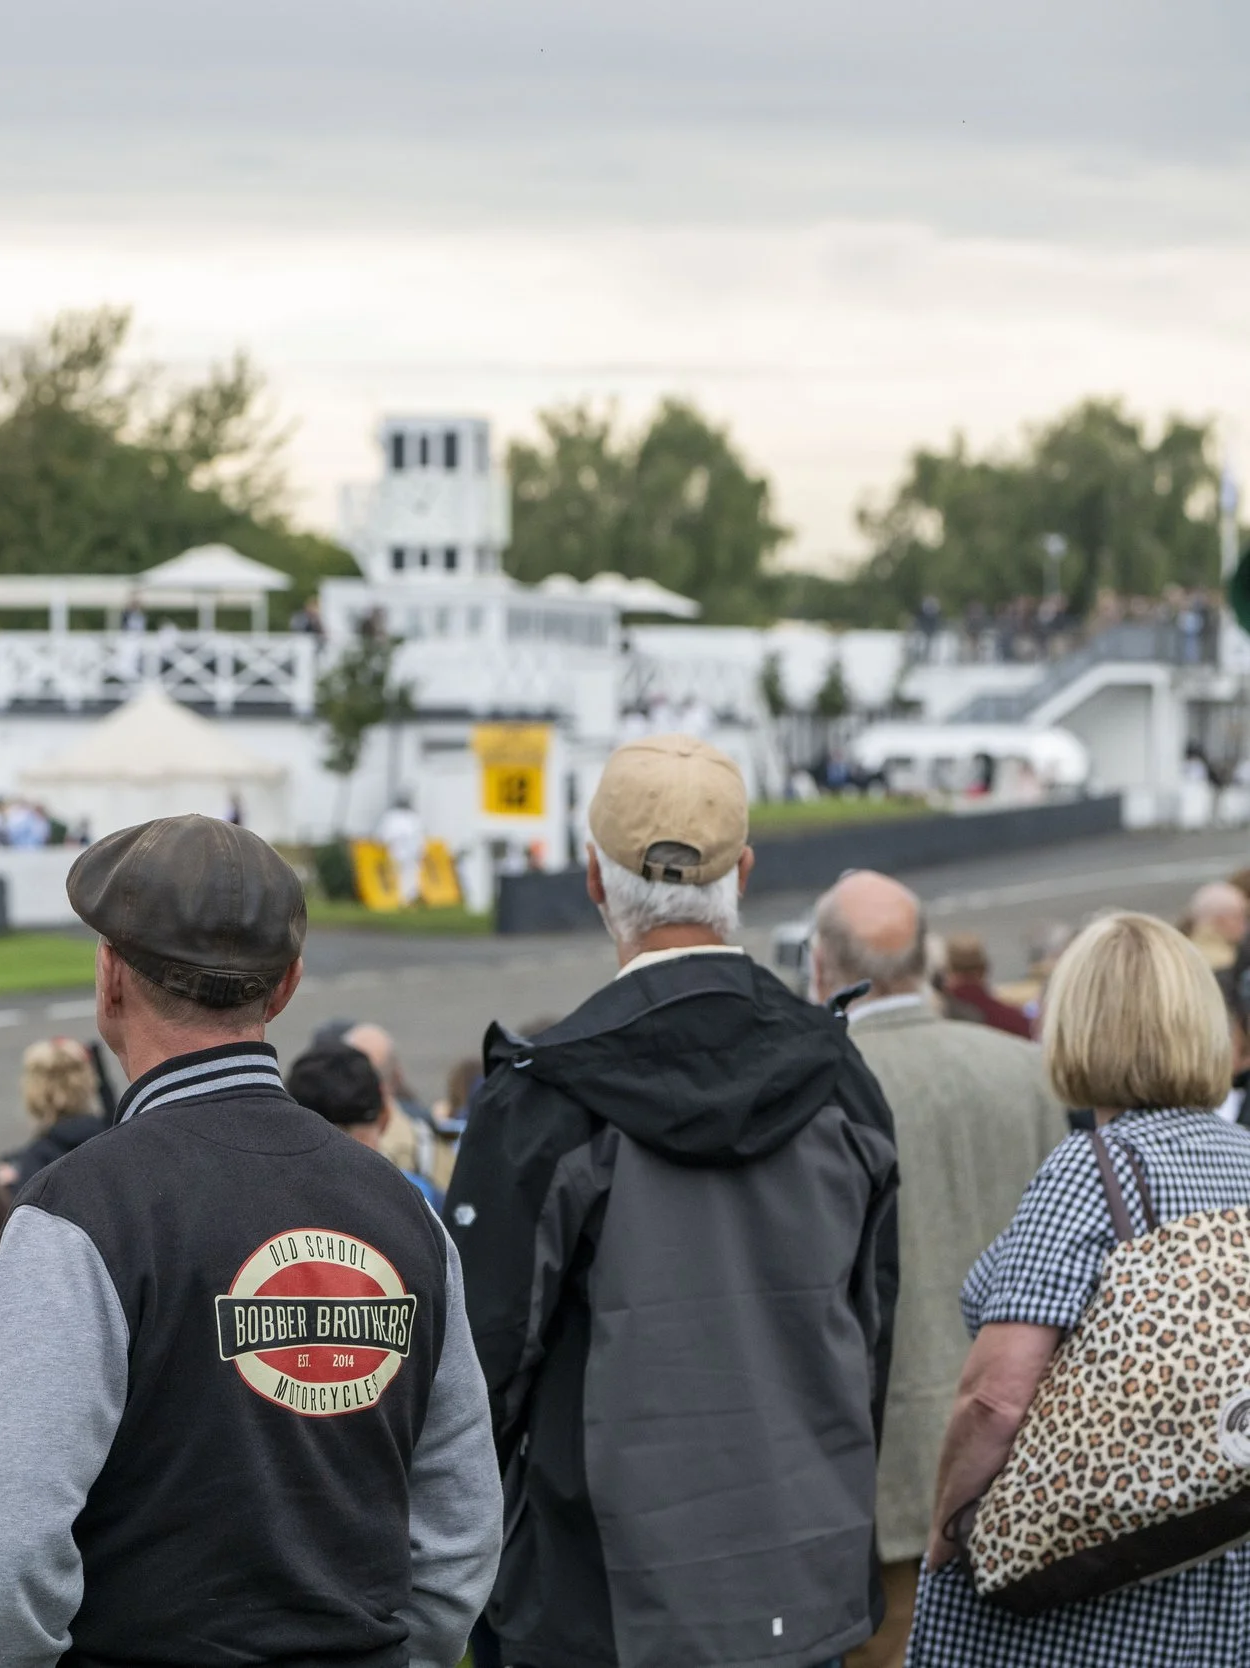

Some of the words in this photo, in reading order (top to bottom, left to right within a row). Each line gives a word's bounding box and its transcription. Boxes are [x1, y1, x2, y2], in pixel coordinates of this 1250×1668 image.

[269, 1236, 299, 1267] OLD
[305, 1235, 367, 1270] SCHOOL
[234, 1305, 308, 1347] BOBBER
[316, 1305, 409, 1346] BROTHERS
[297, 1354, 312, 1367] EST.
[333, 1354, 355, 1367] 2014
[273, 1373, 379, 1411] MOTORCYCLES
